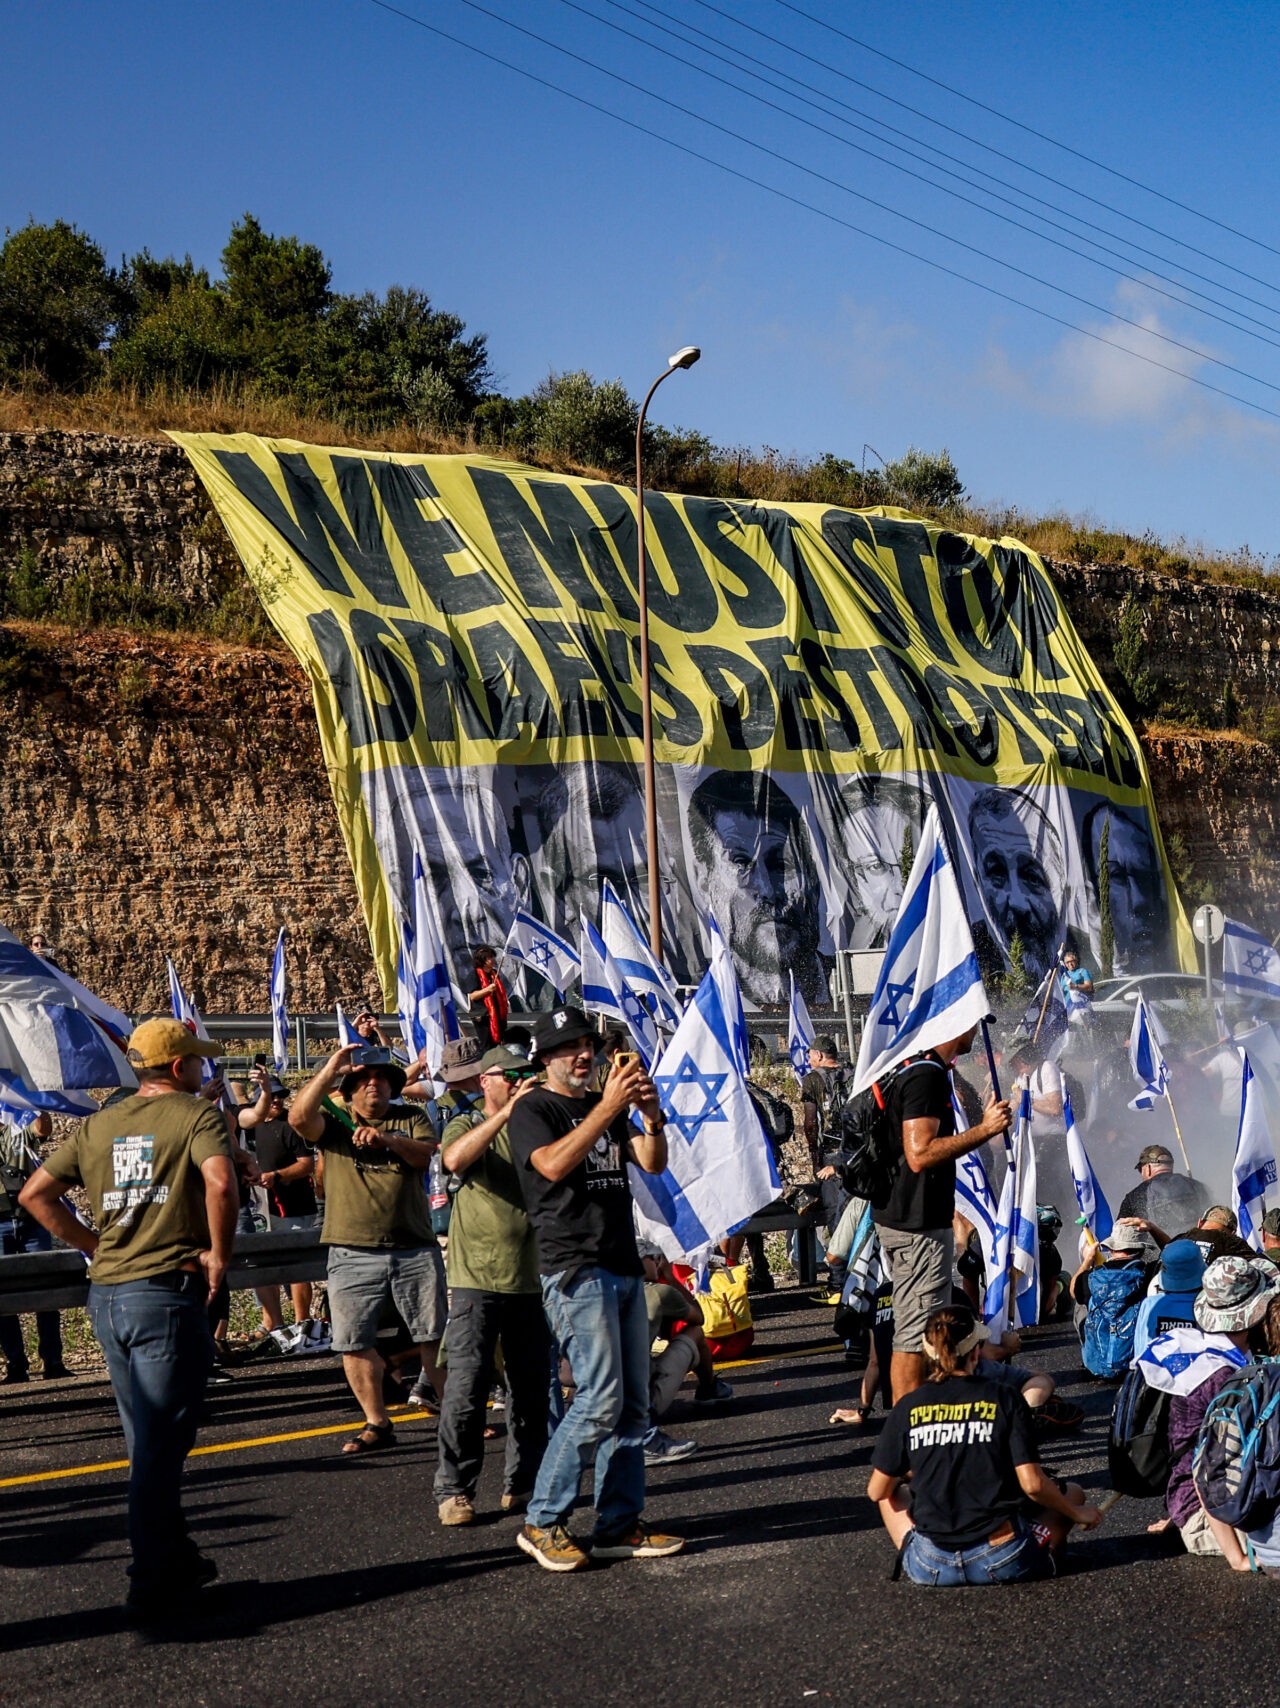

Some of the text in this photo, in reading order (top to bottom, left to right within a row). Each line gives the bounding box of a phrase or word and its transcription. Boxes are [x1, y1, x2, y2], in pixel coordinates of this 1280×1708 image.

[211, 449, 1071, 680] WE MUST STOP
[684, 635, 1142, 789] DESTROYERS
[1160, 1321, 1193, 1331] מחאת
[910, 1400, 997, 1427] בלי דמוקרטיה
[909, 1421, 994, 1451] אין אקדמיה
